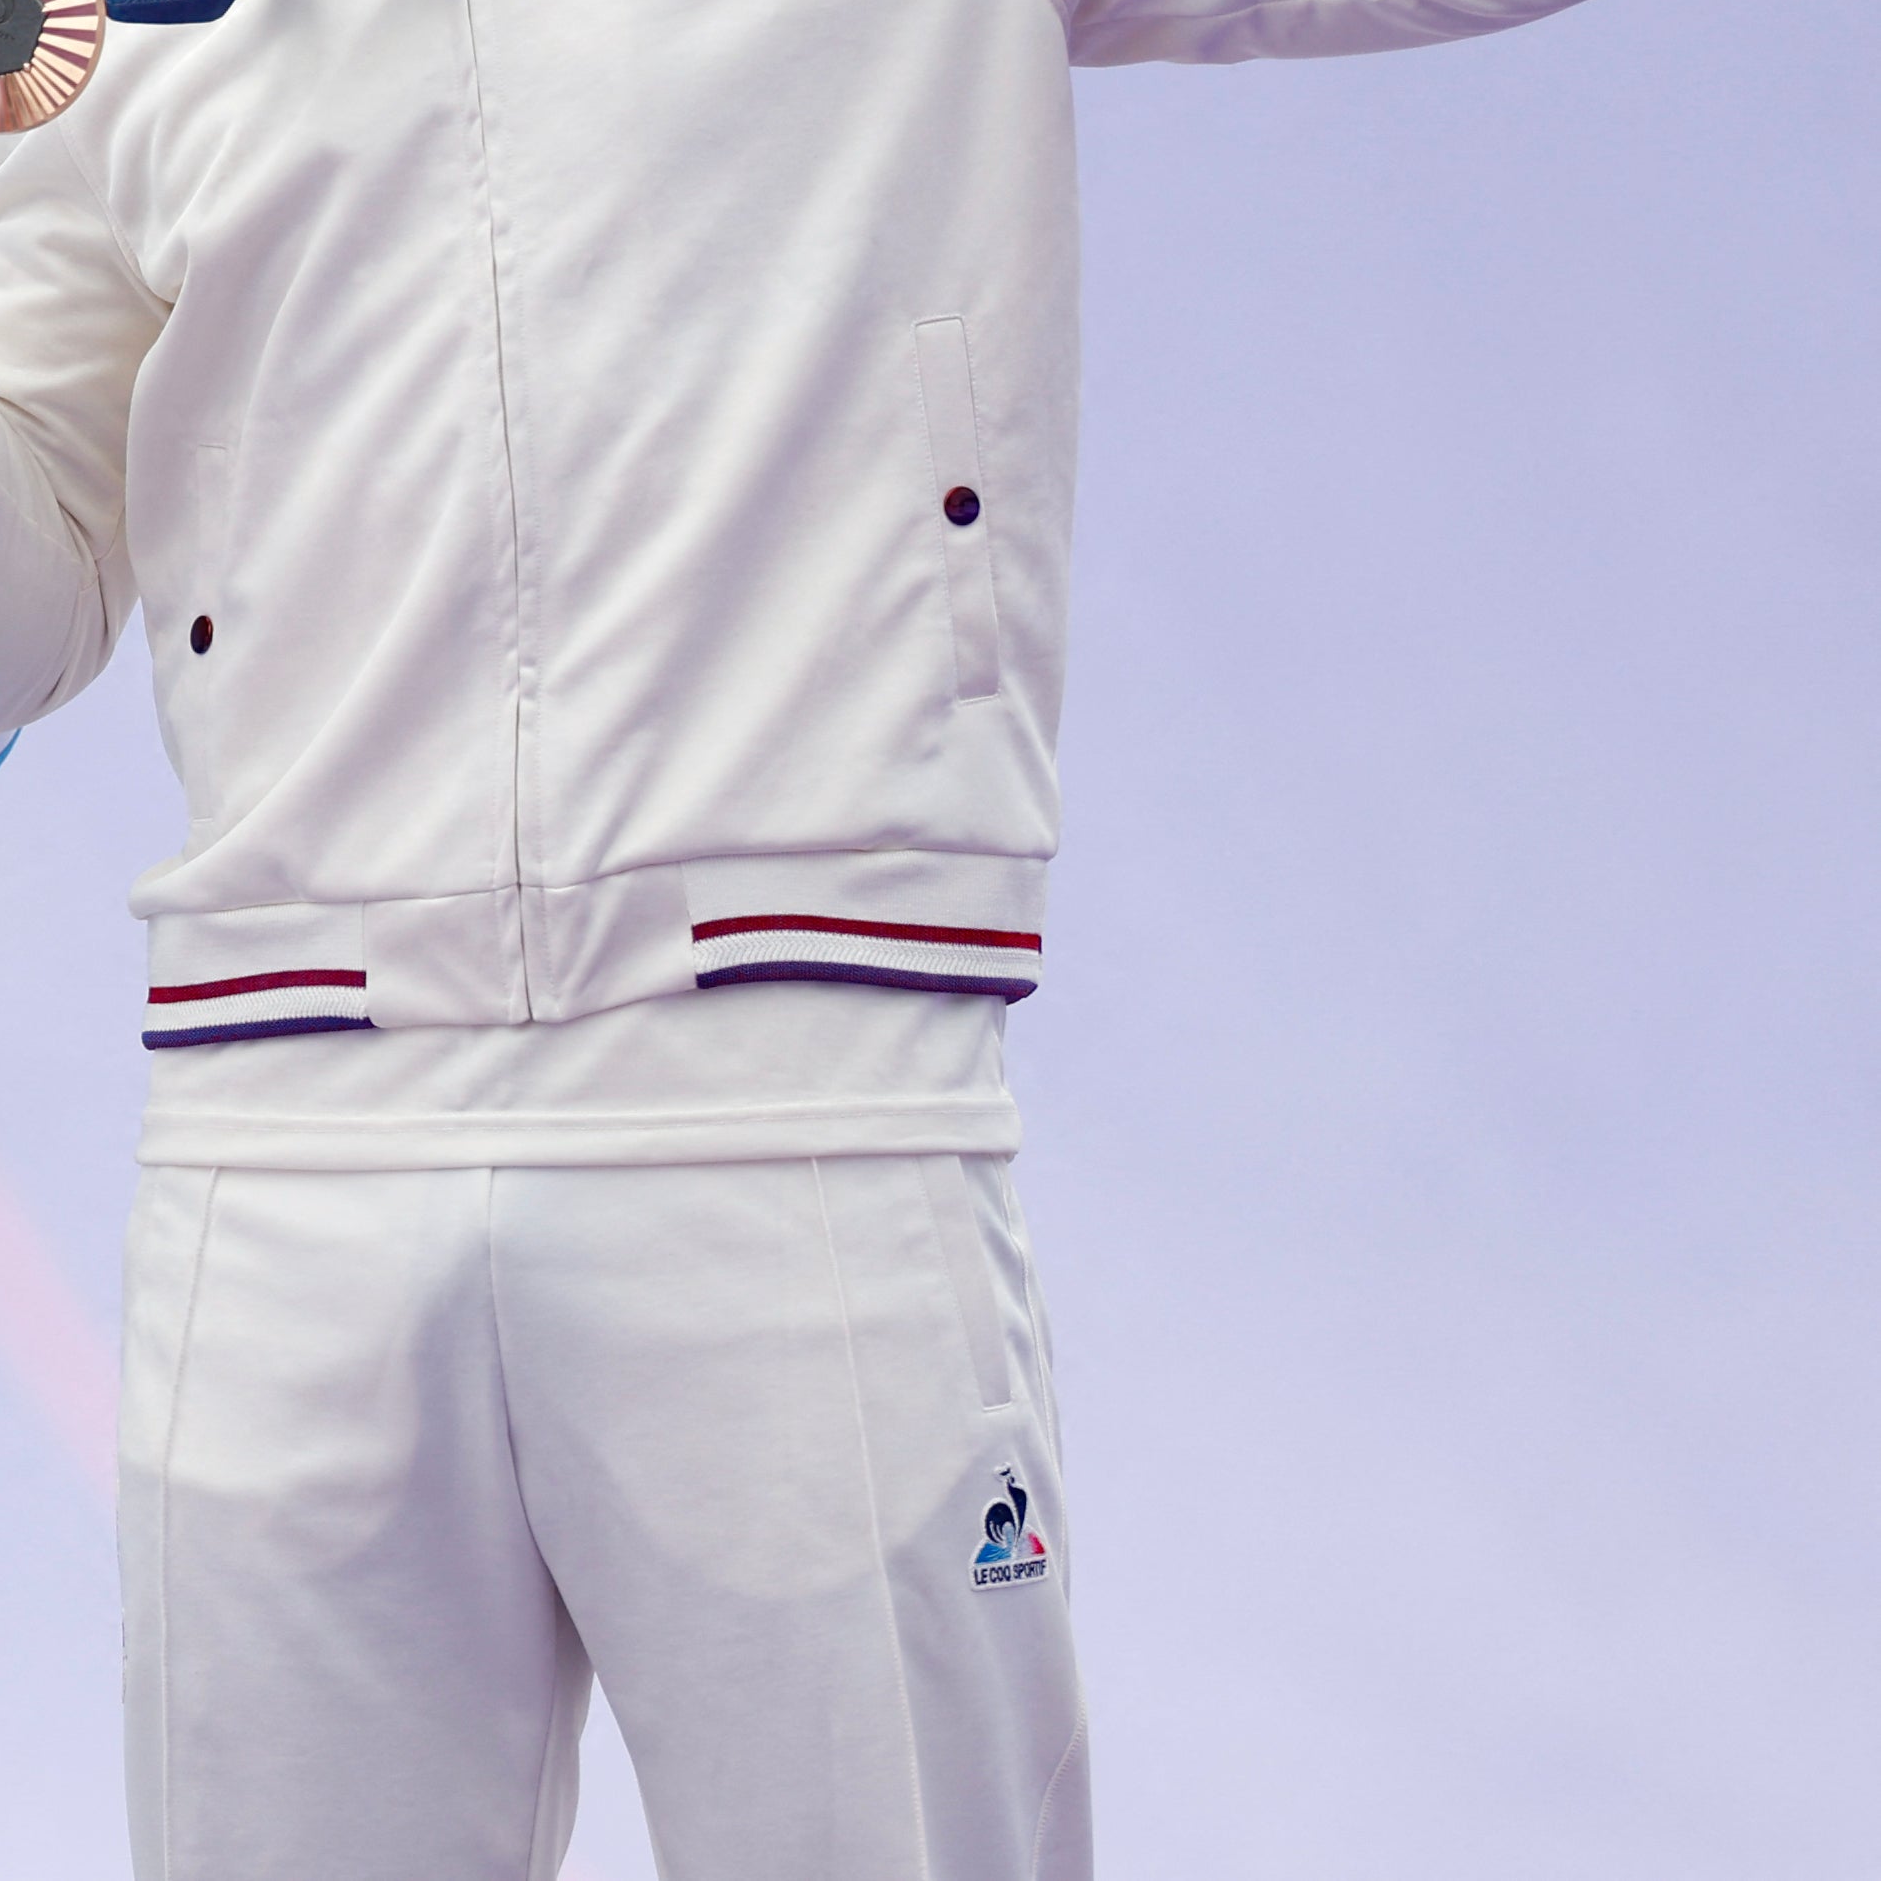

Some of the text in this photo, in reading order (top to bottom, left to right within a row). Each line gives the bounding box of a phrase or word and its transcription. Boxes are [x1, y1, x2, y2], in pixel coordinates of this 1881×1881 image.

[974, 1559, 1047, 1585] LE COQ SPORTIF
